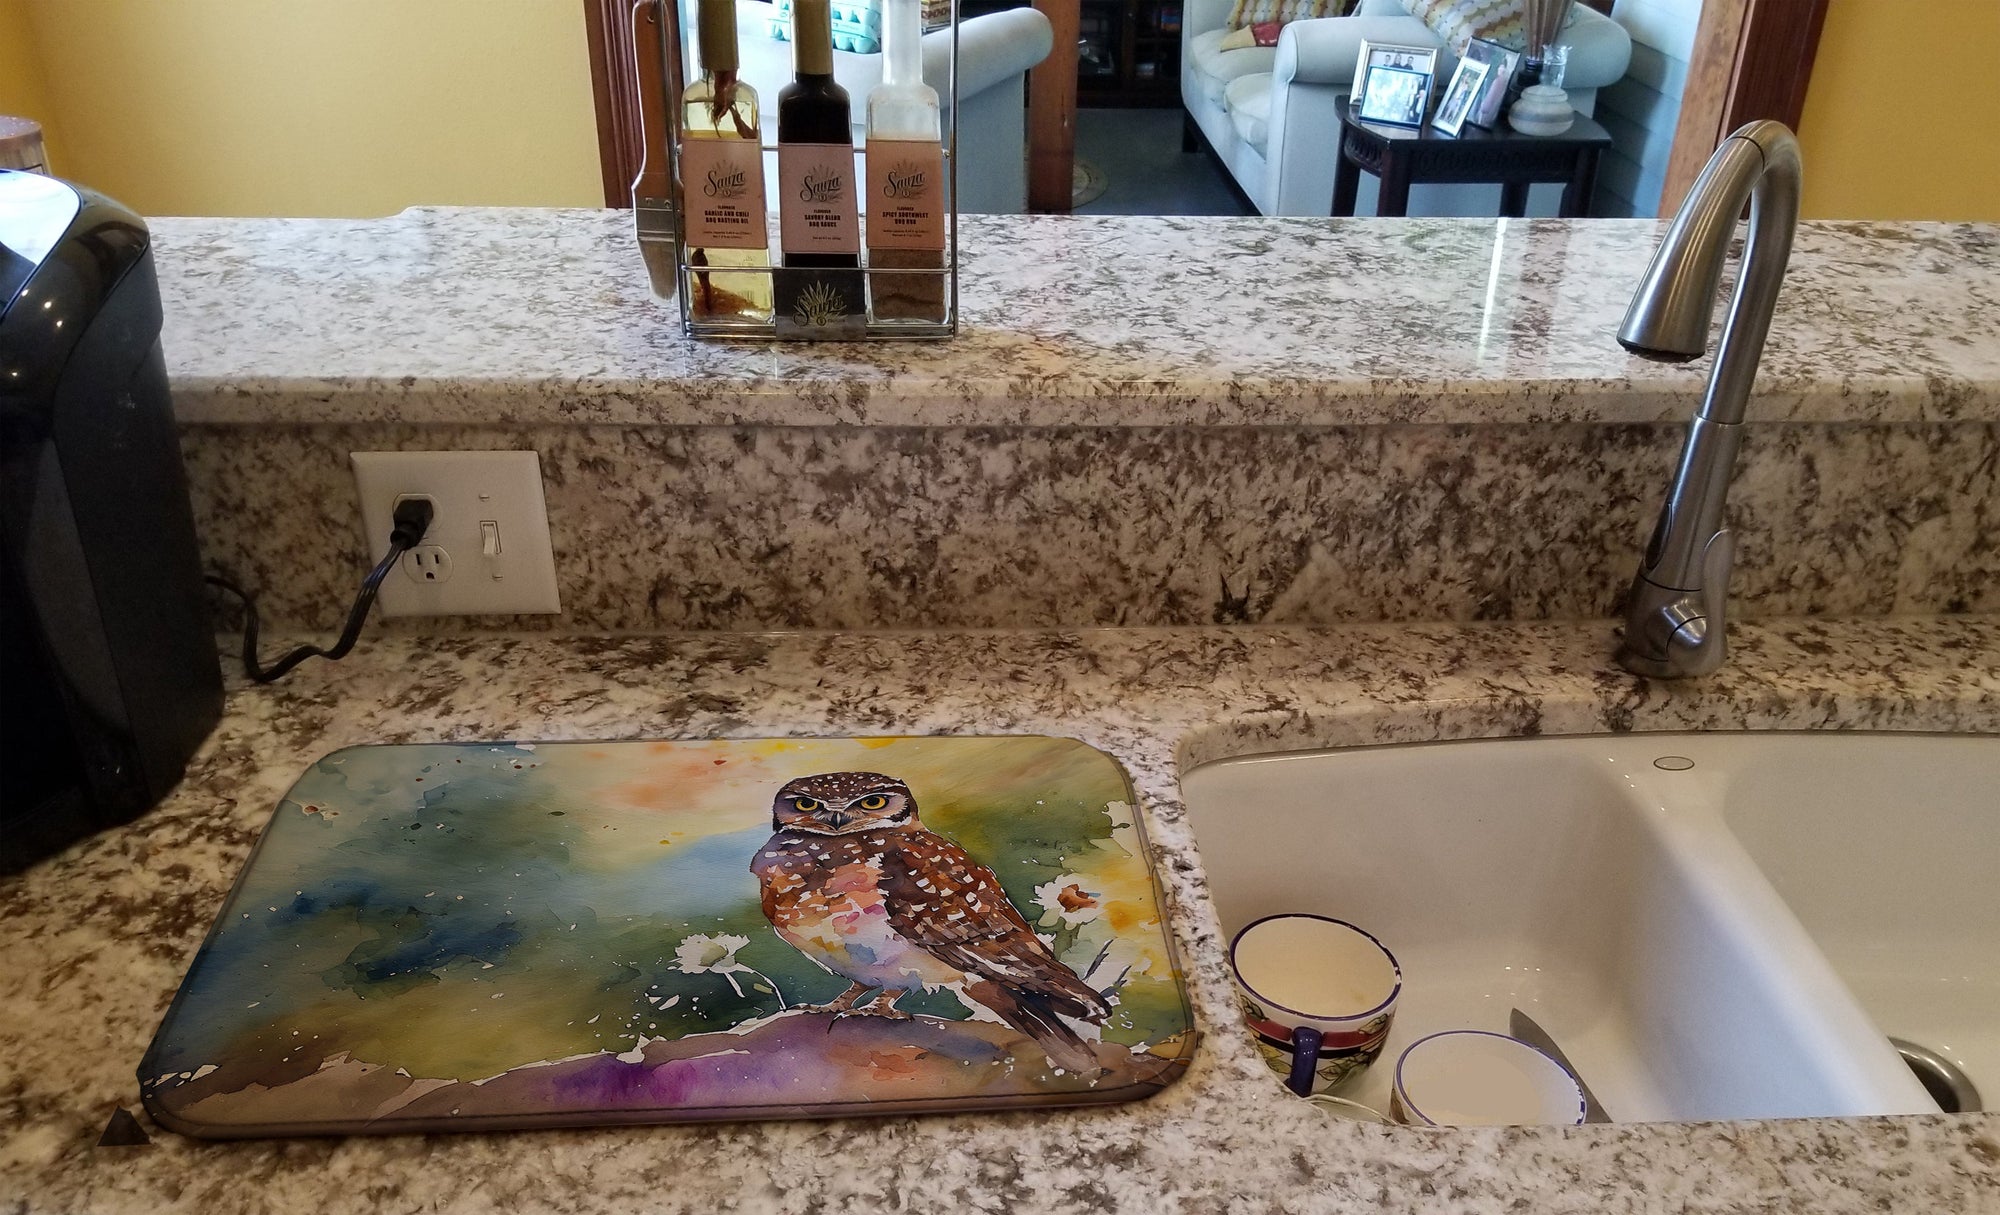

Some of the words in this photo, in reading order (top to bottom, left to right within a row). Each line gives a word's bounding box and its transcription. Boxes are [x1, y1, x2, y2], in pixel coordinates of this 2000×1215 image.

[703, 170, 746, 197] Sauza
[799, 175, 842, 202] Sauza
[883, 171, 926, 198] Sauza
[898, 211, 929, 219] SOUTHWEST
[793, 295, 847, 327] Sauza
